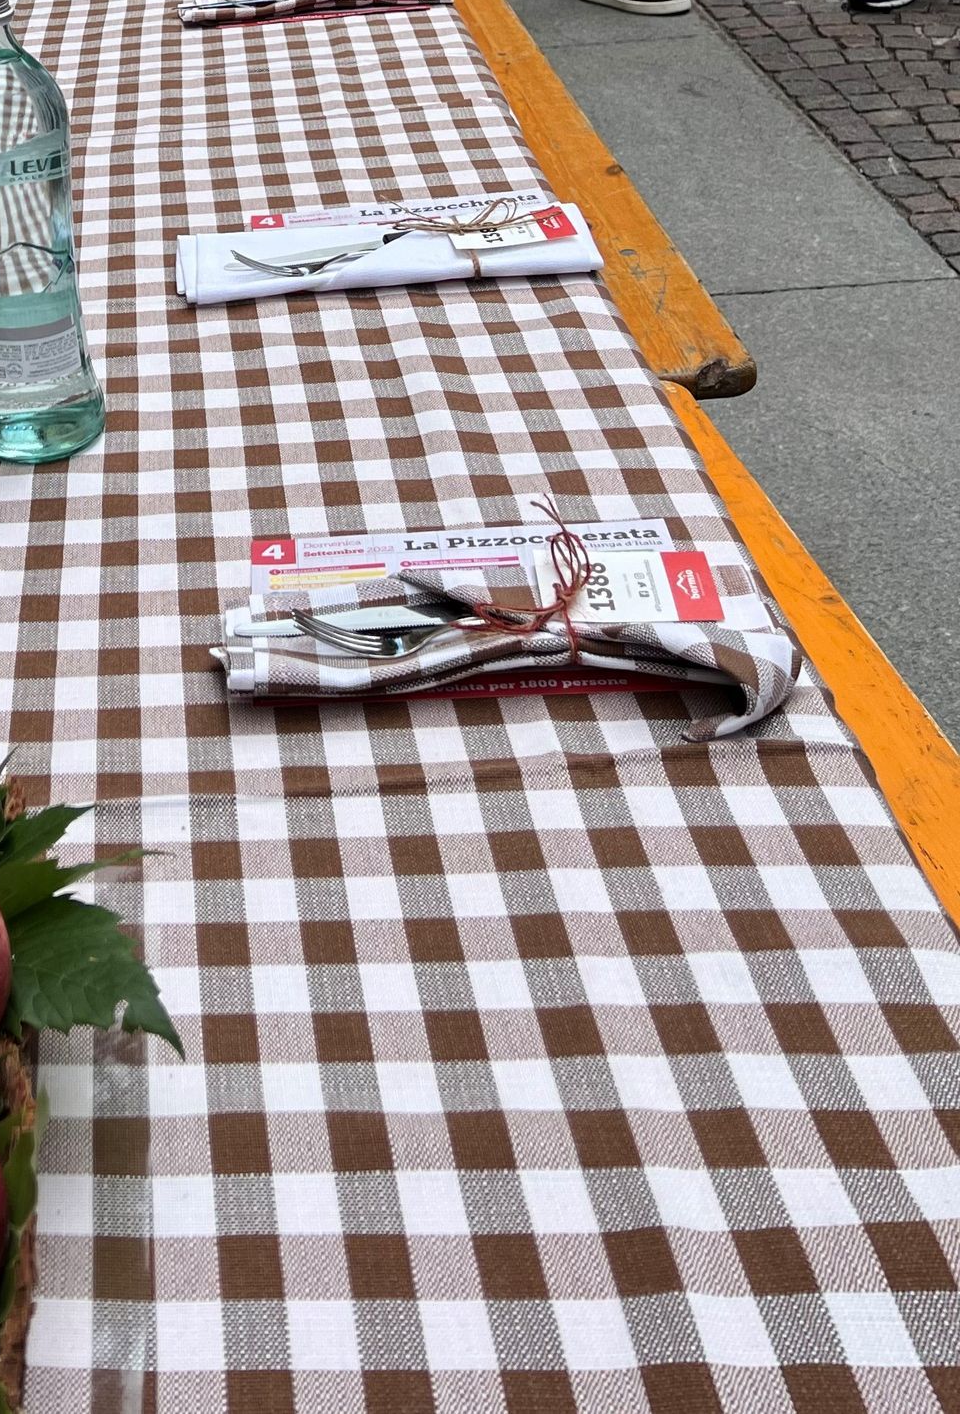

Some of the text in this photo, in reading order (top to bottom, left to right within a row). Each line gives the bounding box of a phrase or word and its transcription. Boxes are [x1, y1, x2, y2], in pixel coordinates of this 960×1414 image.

[258, 216, 276, 227] 4
[360, 209, 385, 217] La
[480, 222, 504, 244] 138
[303, 539, 362, 550] Domenica
[404, 527, 660, 551] La Pizzoccerata
[261, 543, 285, 560] 4
[303, 547, 365, 558] Settembre
[686, 568, 701, 601] bormio
[424, 676, 629, 693] avolata per 1800 persone
